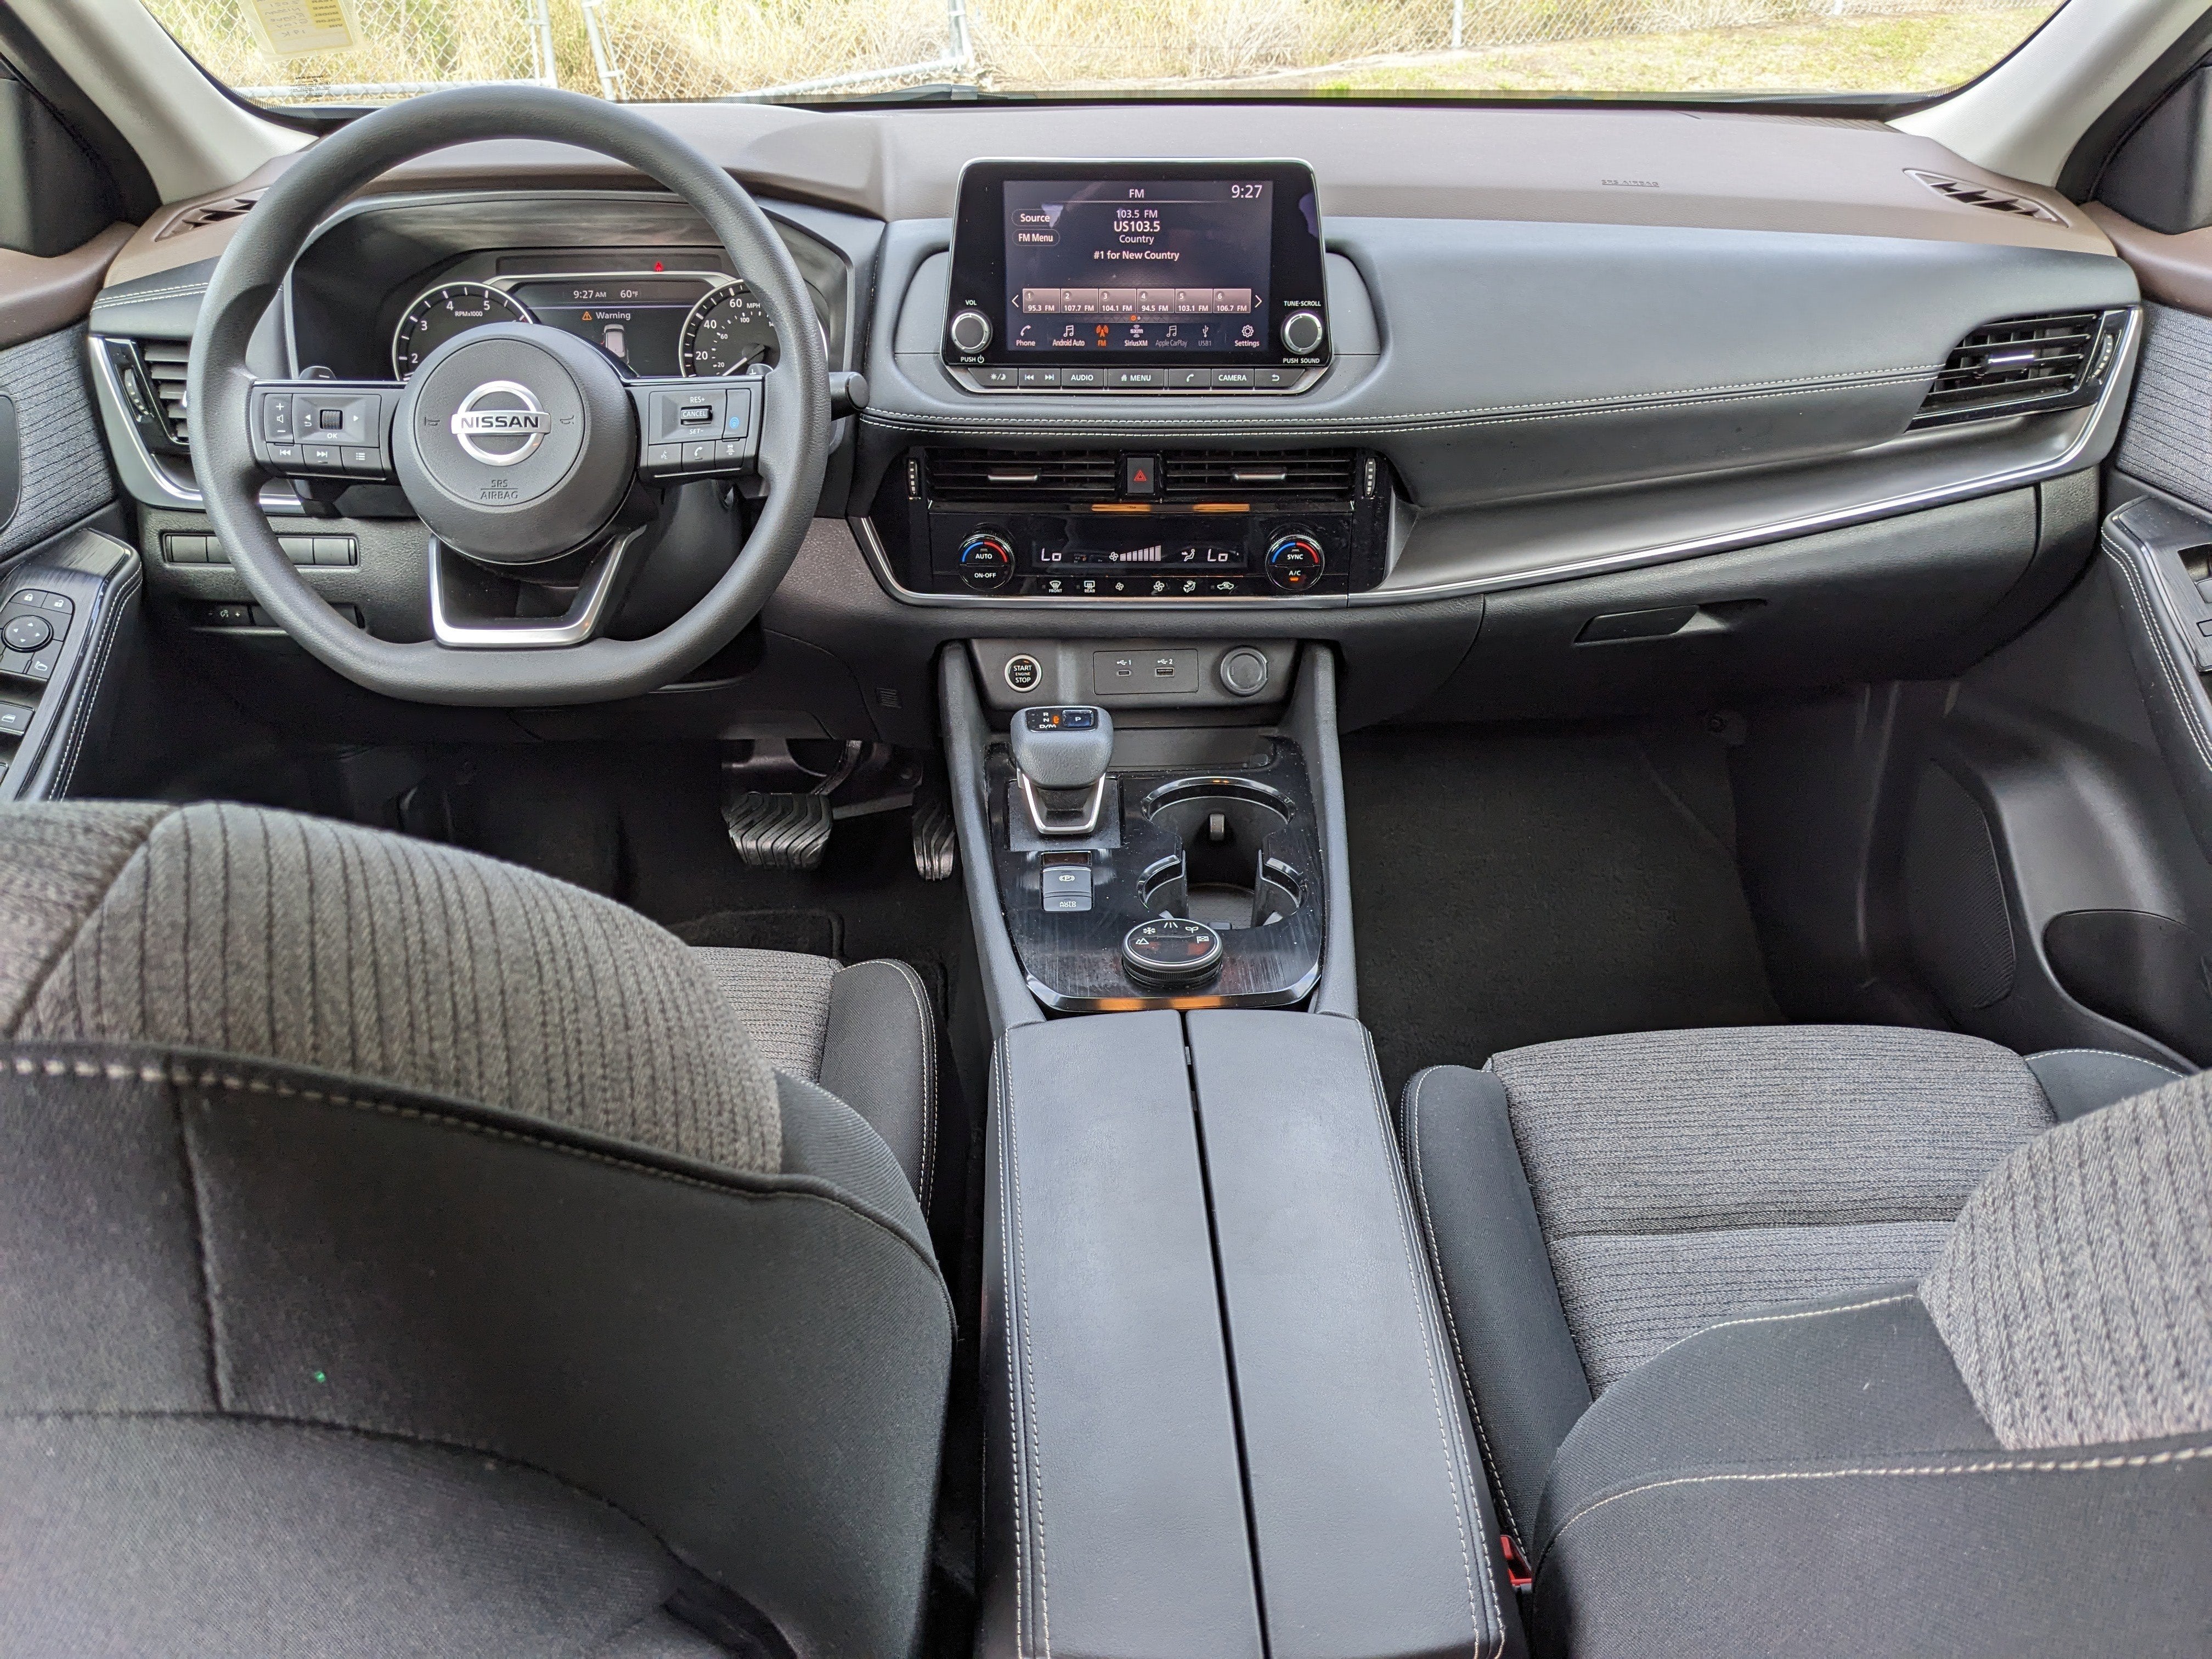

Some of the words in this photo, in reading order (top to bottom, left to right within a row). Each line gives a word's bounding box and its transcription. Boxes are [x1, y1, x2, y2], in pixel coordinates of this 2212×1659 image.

[1129, 189, 1144, 198] FM
[1231, 184, 1262, 199] 9:27
[1020, 213, 1050, 223] Source
[1116, 210, 1139, 218] 103.5
[1144, 210, 1158, 218] FM
[1114, 221, 1160, 233] US103.5
[1018, 234, 1031, 242] FM
[1032, 234, 1053, 242] Menu
[1119, 235, 1154, 245] Country
[1094, 251, 1105, 260] #1
[1107, 250, 1120, 260] for
[1122, 251, 1143, 260] New
[1144, 251, 1180, 261] Country
[573, 290, 594, 299] 9:27
[446, 301, 454, 311] 4
[483, 301, 490, 311] 5
[730, 298, 742, 308] 60
[596, 312, 631, 321] Warning
[421, 320, 428, 331] 3
[703, 319, 716, 329] 40
[411, 353, 418, 363] 2
[696, 351, 708, 360] 20
[461, 416, 539, 429] NISSAN
[491, 479, 508, 488] SRS
[481, 491, 518, 500] AIRBAG
